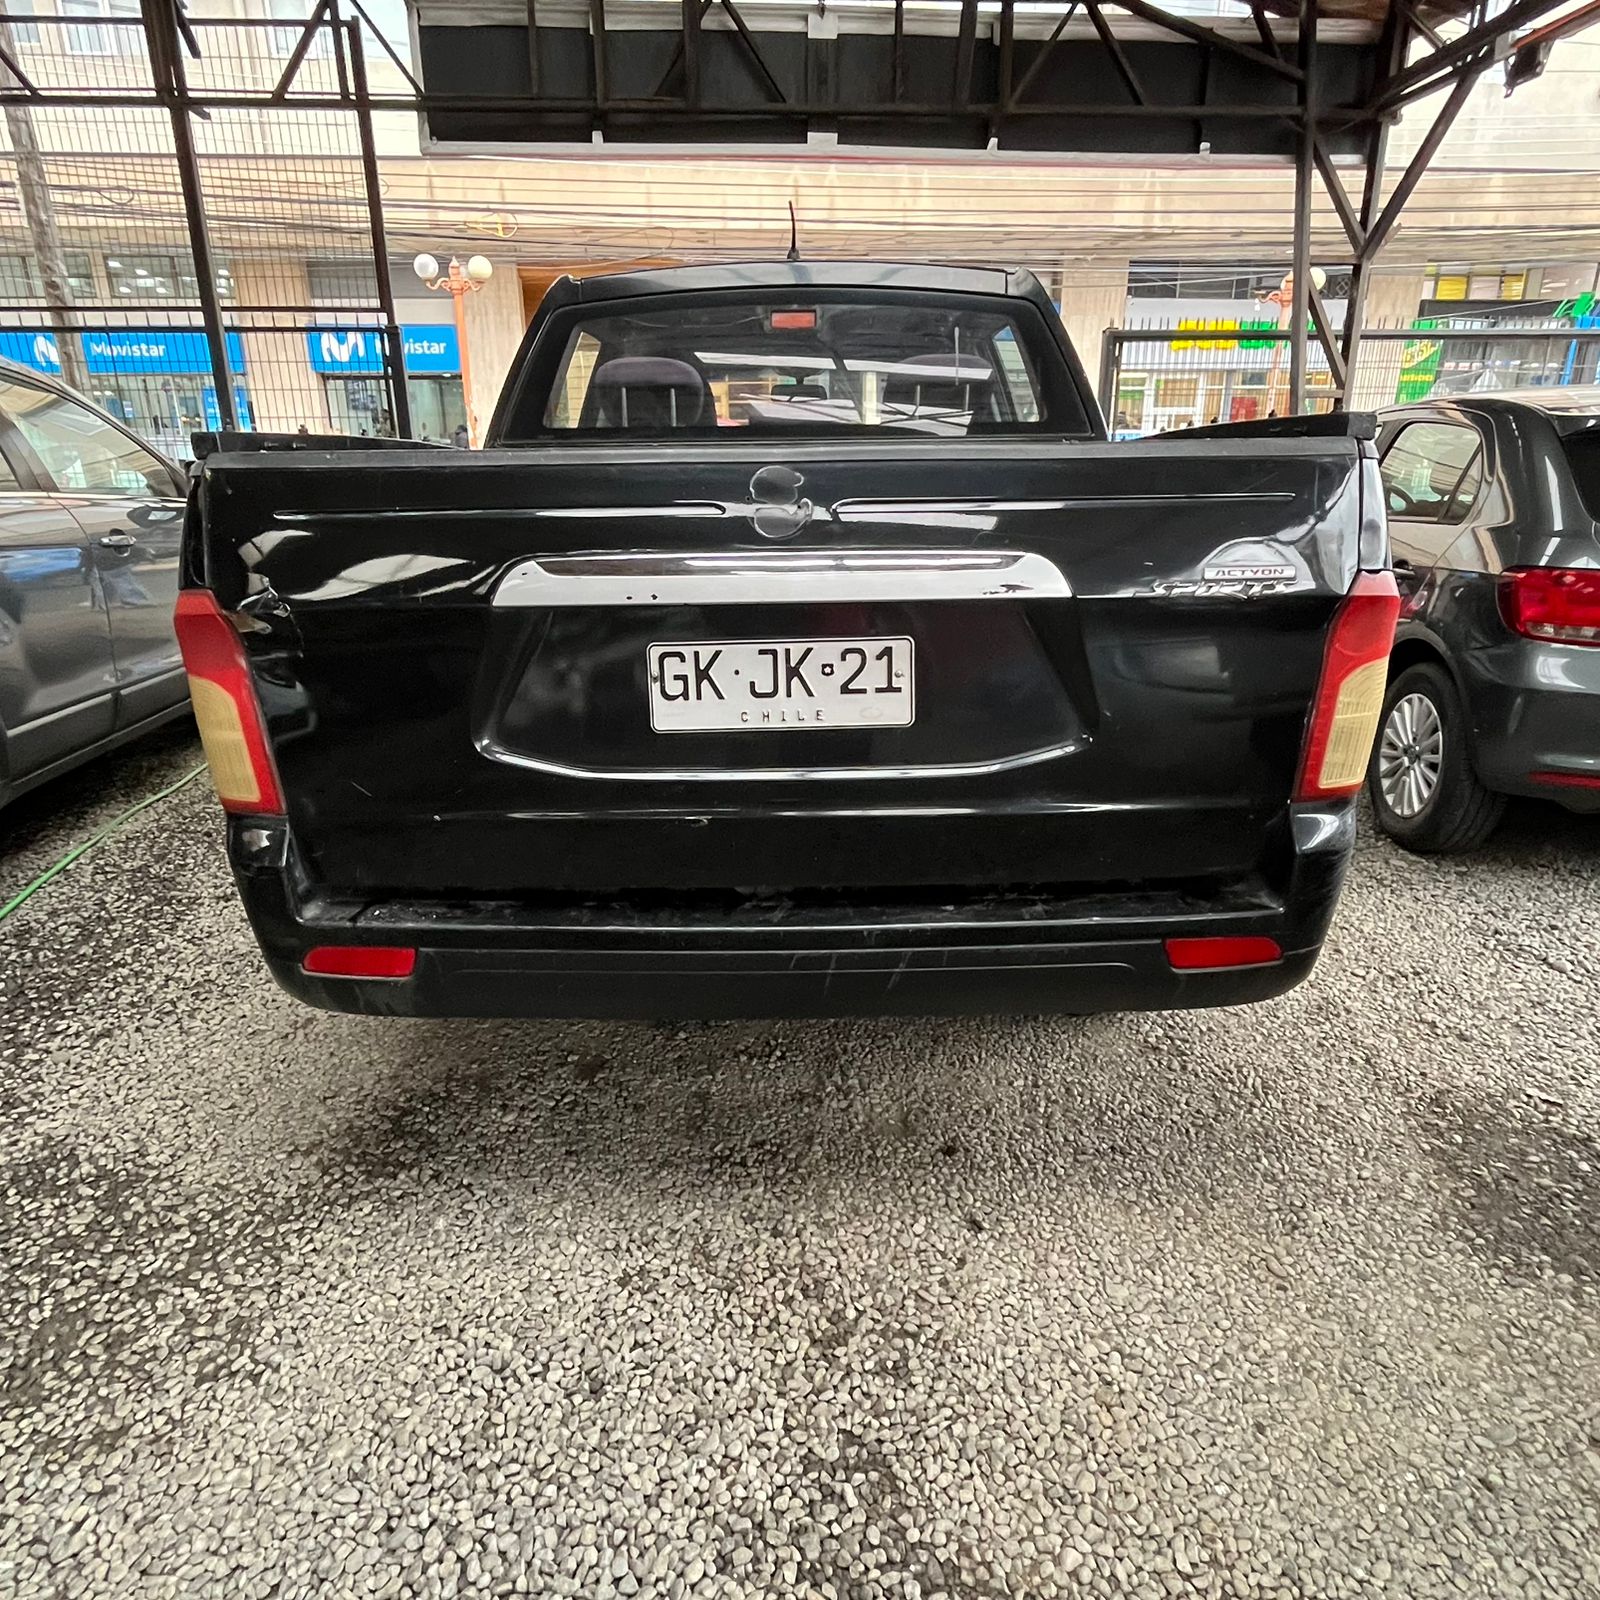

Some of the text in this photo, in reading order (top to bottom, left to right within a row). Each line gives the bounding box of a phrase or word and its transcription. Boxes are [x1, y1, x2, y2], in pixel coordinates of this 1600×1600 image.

[89, 341, 165, 357] Movistar
[1215, 568, 1284, 577] ACTYON
[740, 710, 825, 723] CHILE
